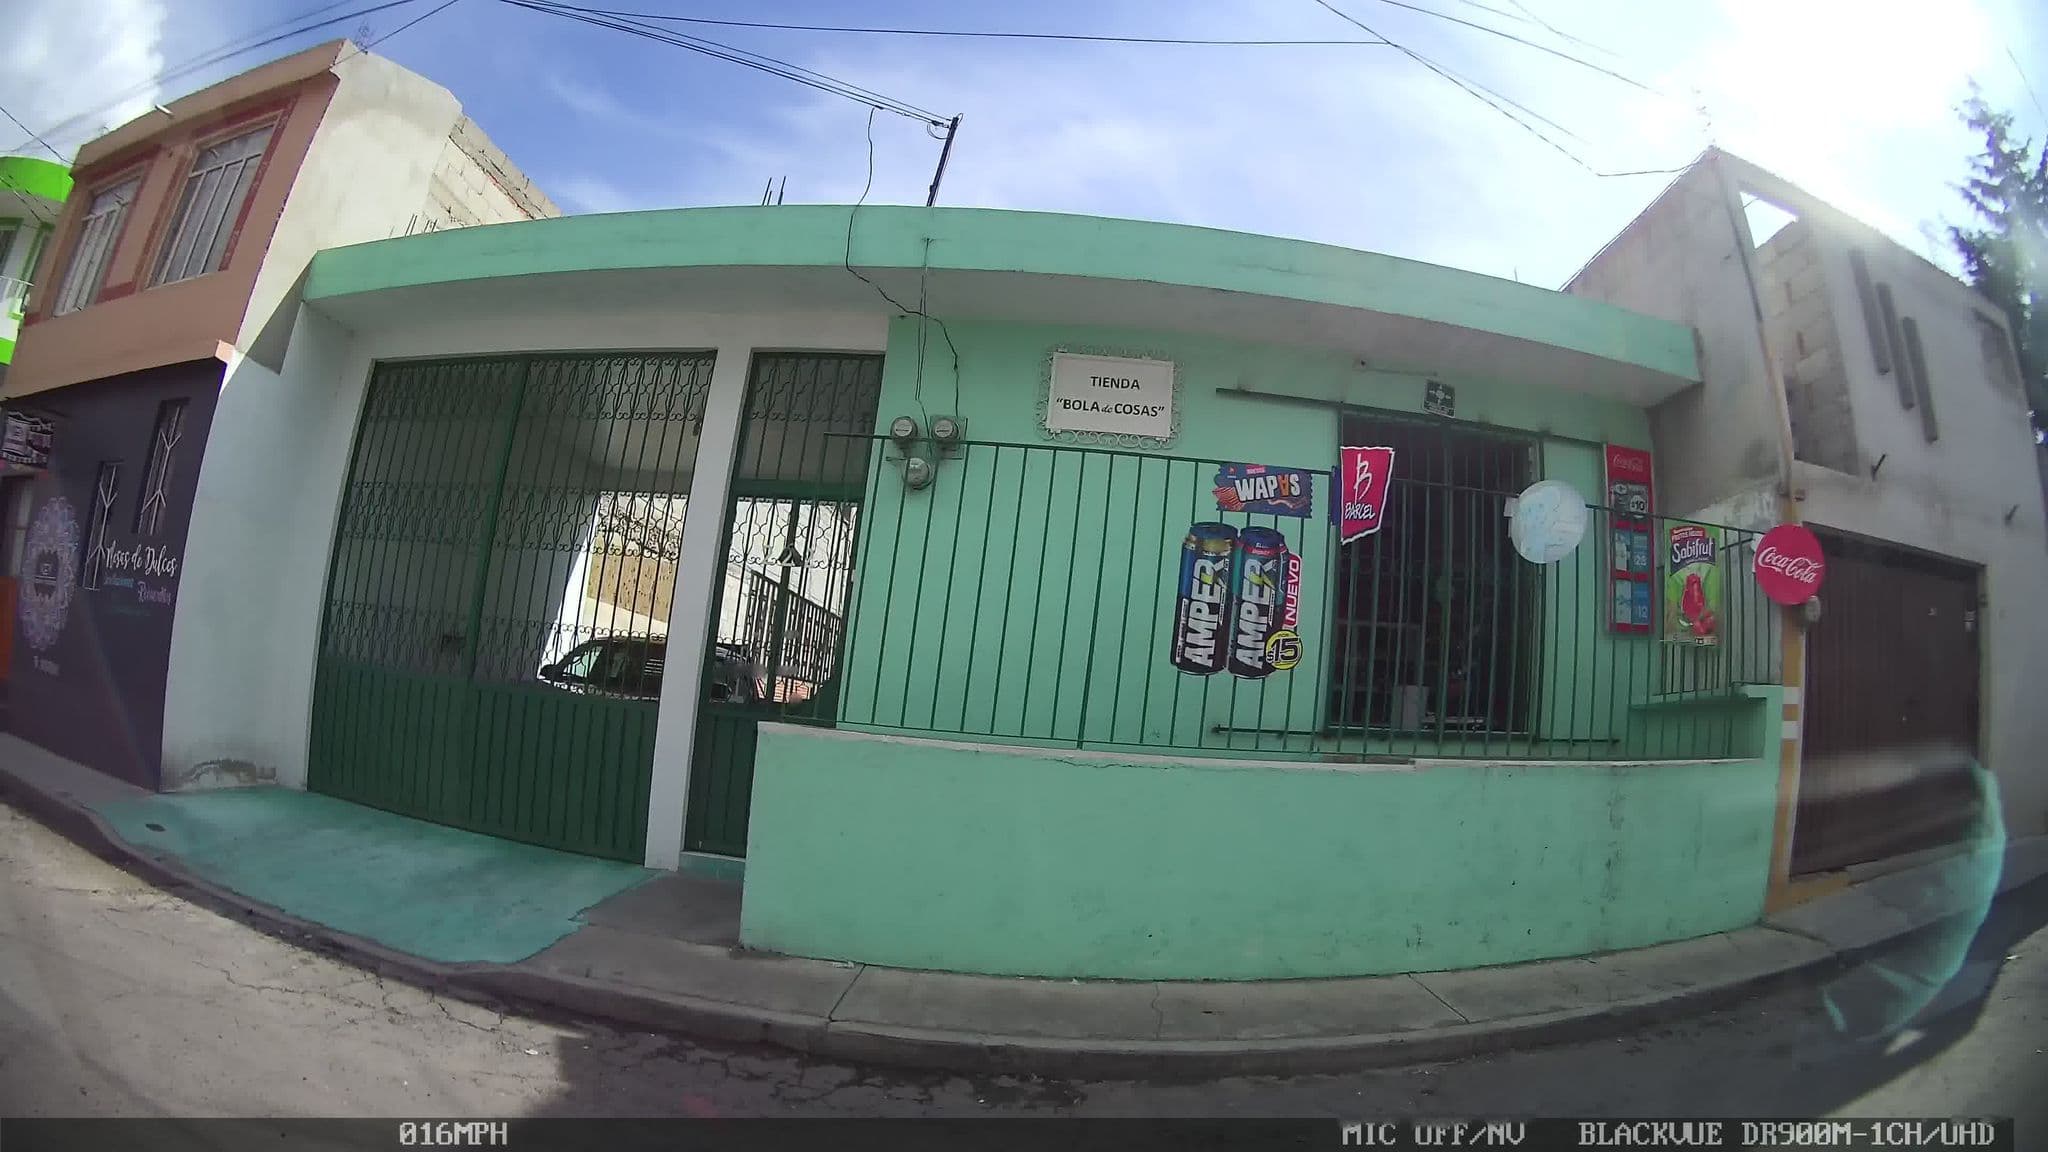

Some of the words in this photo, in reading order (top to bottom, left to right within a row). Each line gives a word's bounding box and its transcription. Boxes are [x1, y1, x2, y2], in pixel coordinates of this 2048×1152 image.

[1090, 376, 1140, 390] TIENDA
[1101, 404, 1113, 413] de
[1234, 473, 1301, 502] WAPAS
[1344, 502, 1377, 521] BARCEL
[144, 545, 178, 577] Dulces
[1672, 537, 1714, 563] Sabifrut
[1758, 546, 1824, 583] Coca-Cola
[1284, 559, 1301, 626] NUEVO
[1184, 558, 1225, 668] AMPER
[1235, 558, 1276, 669] AMPER
[1265, 637, 1300, 663] $15
